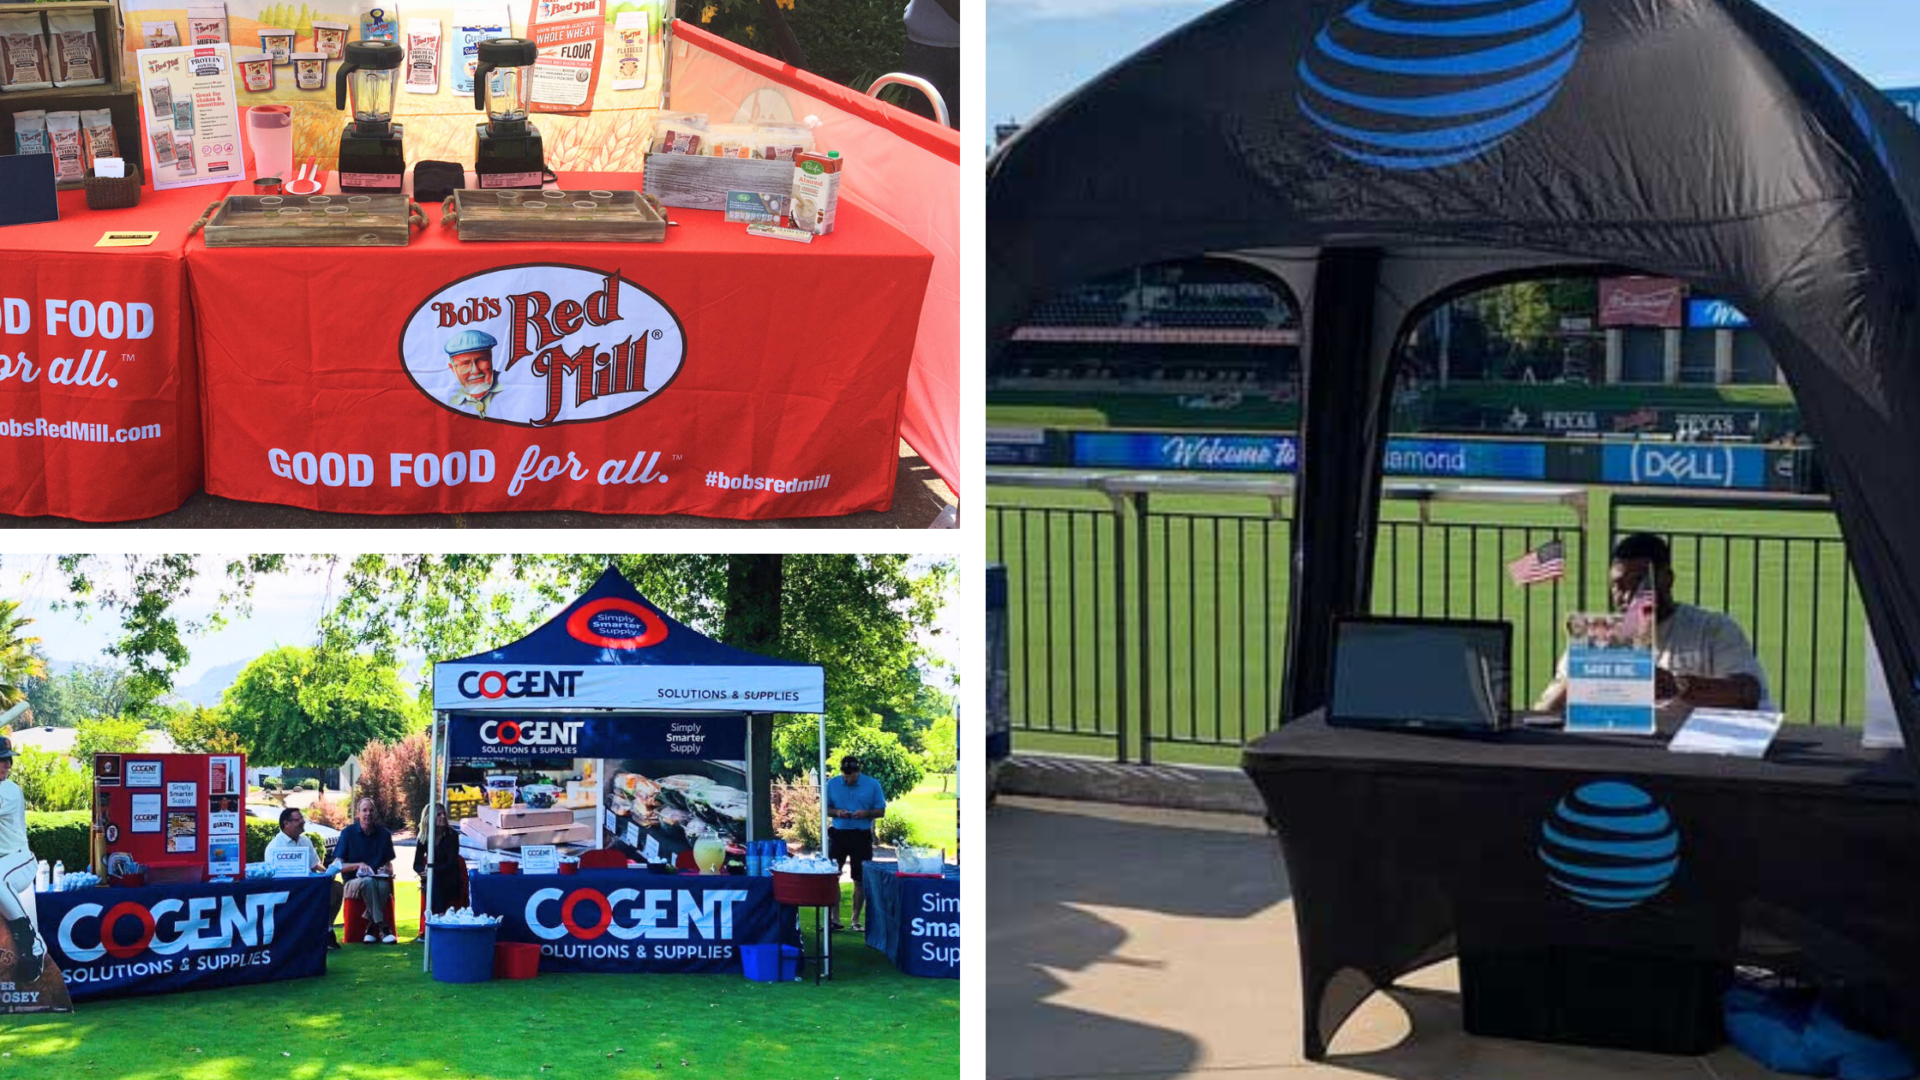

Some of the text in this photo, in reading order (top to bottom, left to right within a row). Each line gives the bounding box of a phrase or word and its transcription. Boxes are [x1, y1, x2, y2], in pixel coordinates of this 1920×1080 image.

[550, 0, 596, 17] Red Mill
[536, 26, 595, 44] WHOLE WHEAT
[561, 43, 592, 59] FLOUR
[804, 162, 821, 173] Pacific
[799, 177, 823, 186] Almond
[46, 298, 154, 340] FOOD
[431, 268, 624, 372] Bob's Red
[48, 348, 118, 388] all.
[530, 329, 649, 428] Mill
[0, 418, 161, 442] obsRedMill.com
[1543, 414, 1597, 429] TEXAS
[1676, 418, 1734, 434] TEXAS
[1162, 436, 1465, 471] Welcome to iamond
[268, 448, 374, 487] GOOD
[390, 450, 495, 487] FOOD
[508, 445, 589, 496] for
[598, 451, 669, 485] all.
[705, 470, 830, 494] #bobsredmill
[593, 621, 642, 629] Smarter
[598, 614, 635, 623] Simply
[458, 670, 799, 701] COGENT SOLUTIONS & SUPPLIES
[480, 720, 585, 745] COGENT
[671, 722, 701, 733] Simply
[666, 733, 705, 742] Smarter
[670, 743, 701, 754] Supply
[172, 784, 191, 792] Simply
[922, 893, 960, 912] Sim
[525, 888, 748, 940] COGENT
[58, 891, 290, 962] COGENT
[911, 918, 960, 937] Sma
[541, 944, 733, 959] OLUTIONS & SUPPLIES
[62, 950, 271, 983] SOLUTIONS & SUPPLIES
[2, 992, 40, 1003] OSEY
